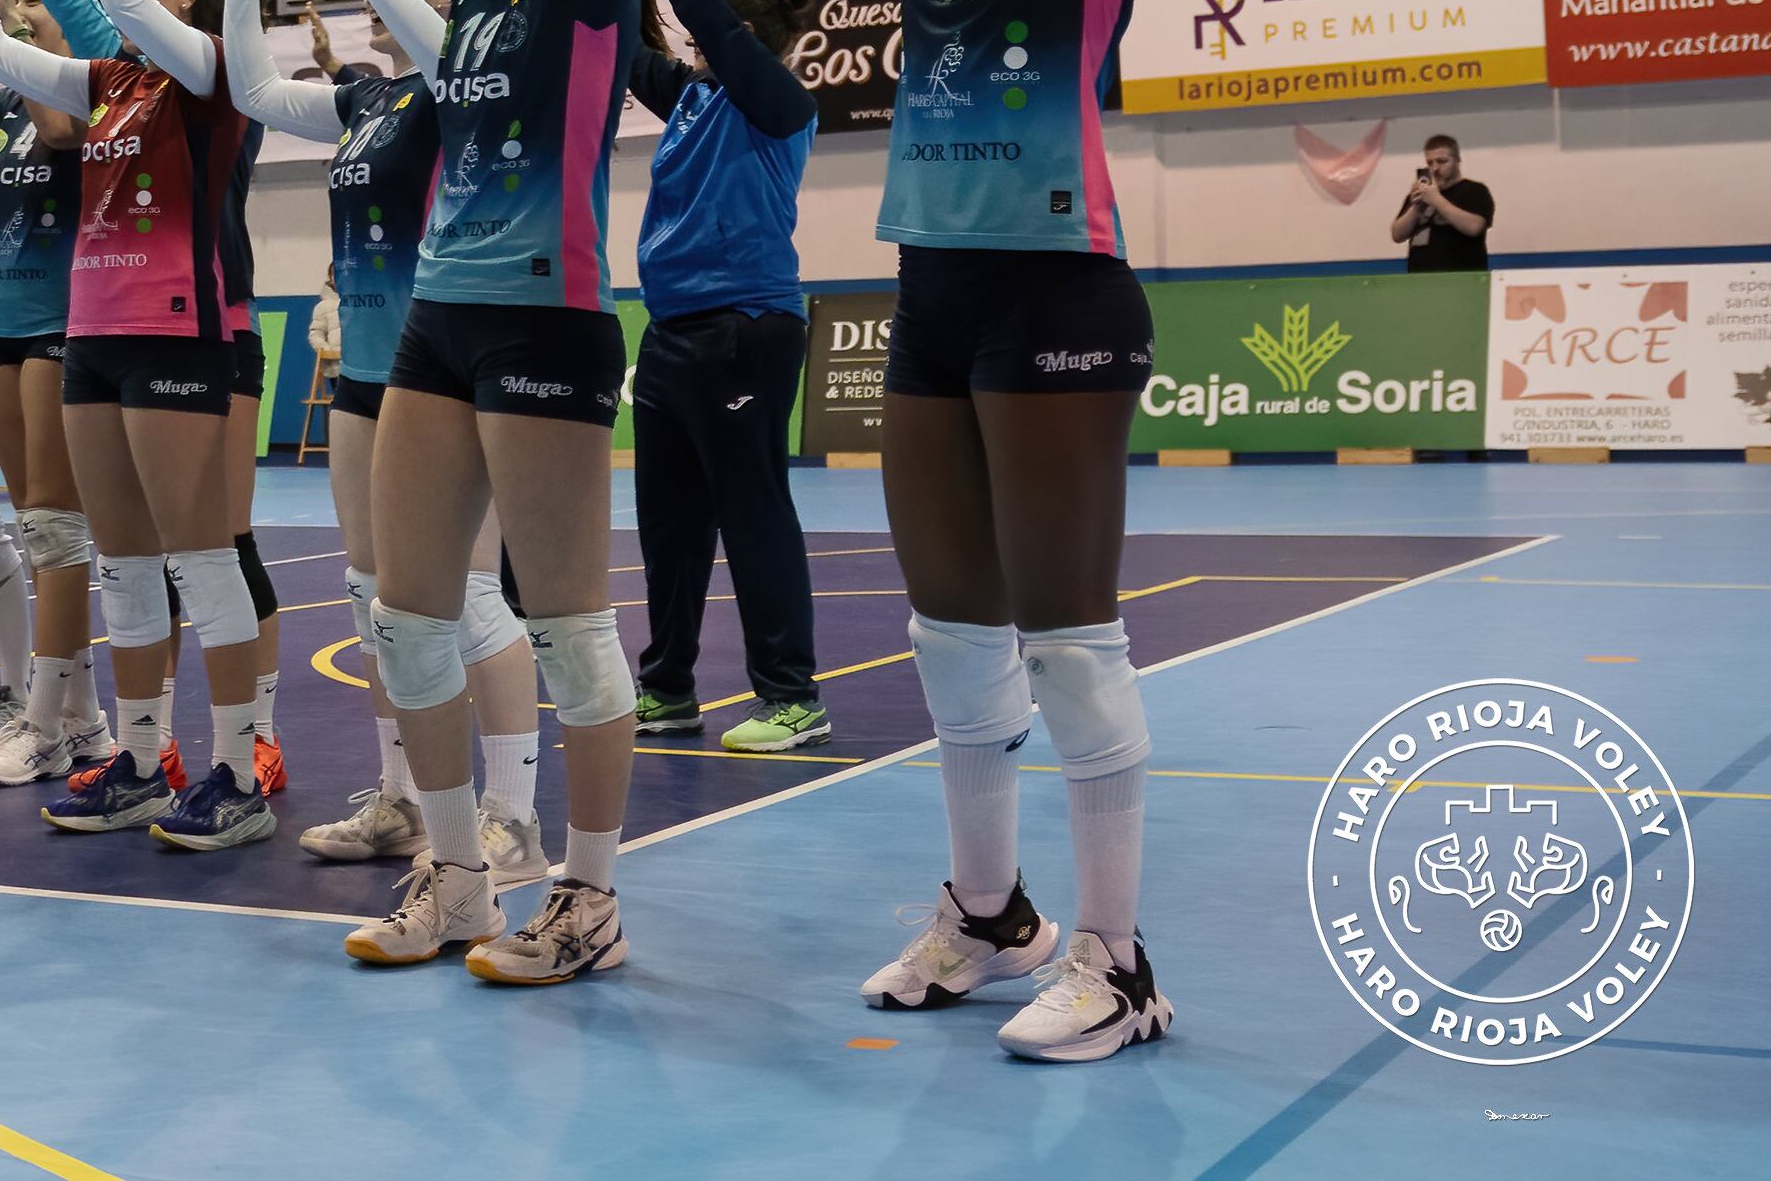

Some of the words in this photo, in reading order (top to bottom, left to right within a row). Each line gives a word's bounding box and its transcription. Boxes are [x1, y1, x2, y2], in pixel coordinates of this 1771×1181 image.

[1264, 6, 1468, 44] PREMIUM
[453, 11, 507, 72] 19
[990, 71, 1019, 82] eco
[1022, 70, 1041, 82] 3G
[1177, 59, 1483, 102] lariojapremium.com
[435, 72, 510, 106] ocisa
[9, 120, 38, 160] 4
[82, 134, 142, 164] ocisa
[949, 142, 1022, 162] TINTO
[491, 160, 516, 171] eco
[518, 159, 531, 169] 3G
[329, 162, 371, 190] cisa
[464, 219, 513, 237] TINTO
[103, 253, 148, 268] TINTO
[1728, 280, 1771, 294] espe
[1725, 295, 1771, 310] sanid
[1718, 328, 1771, 343] semill
[1521, 326, 1677, 368] ARCE
[1034, 350, 1113, 372] Muga
[827, 367, 884, 384] DISEÑO
[149, 379, 208, 395] Muga
[500, 375, 573, 398] Muga
[825, 386, 840, 399] &
[1140, 374, 1250, 427] Caja
[1255, 395, 1300, 415] rural
[1304, 395, 1331, 415] de
[1336, 369, 1478, 415] Soria
[1546, 406, 1672, 418] ENTRECARRETERAS
[1631, 419, 1672, 431] HARO
